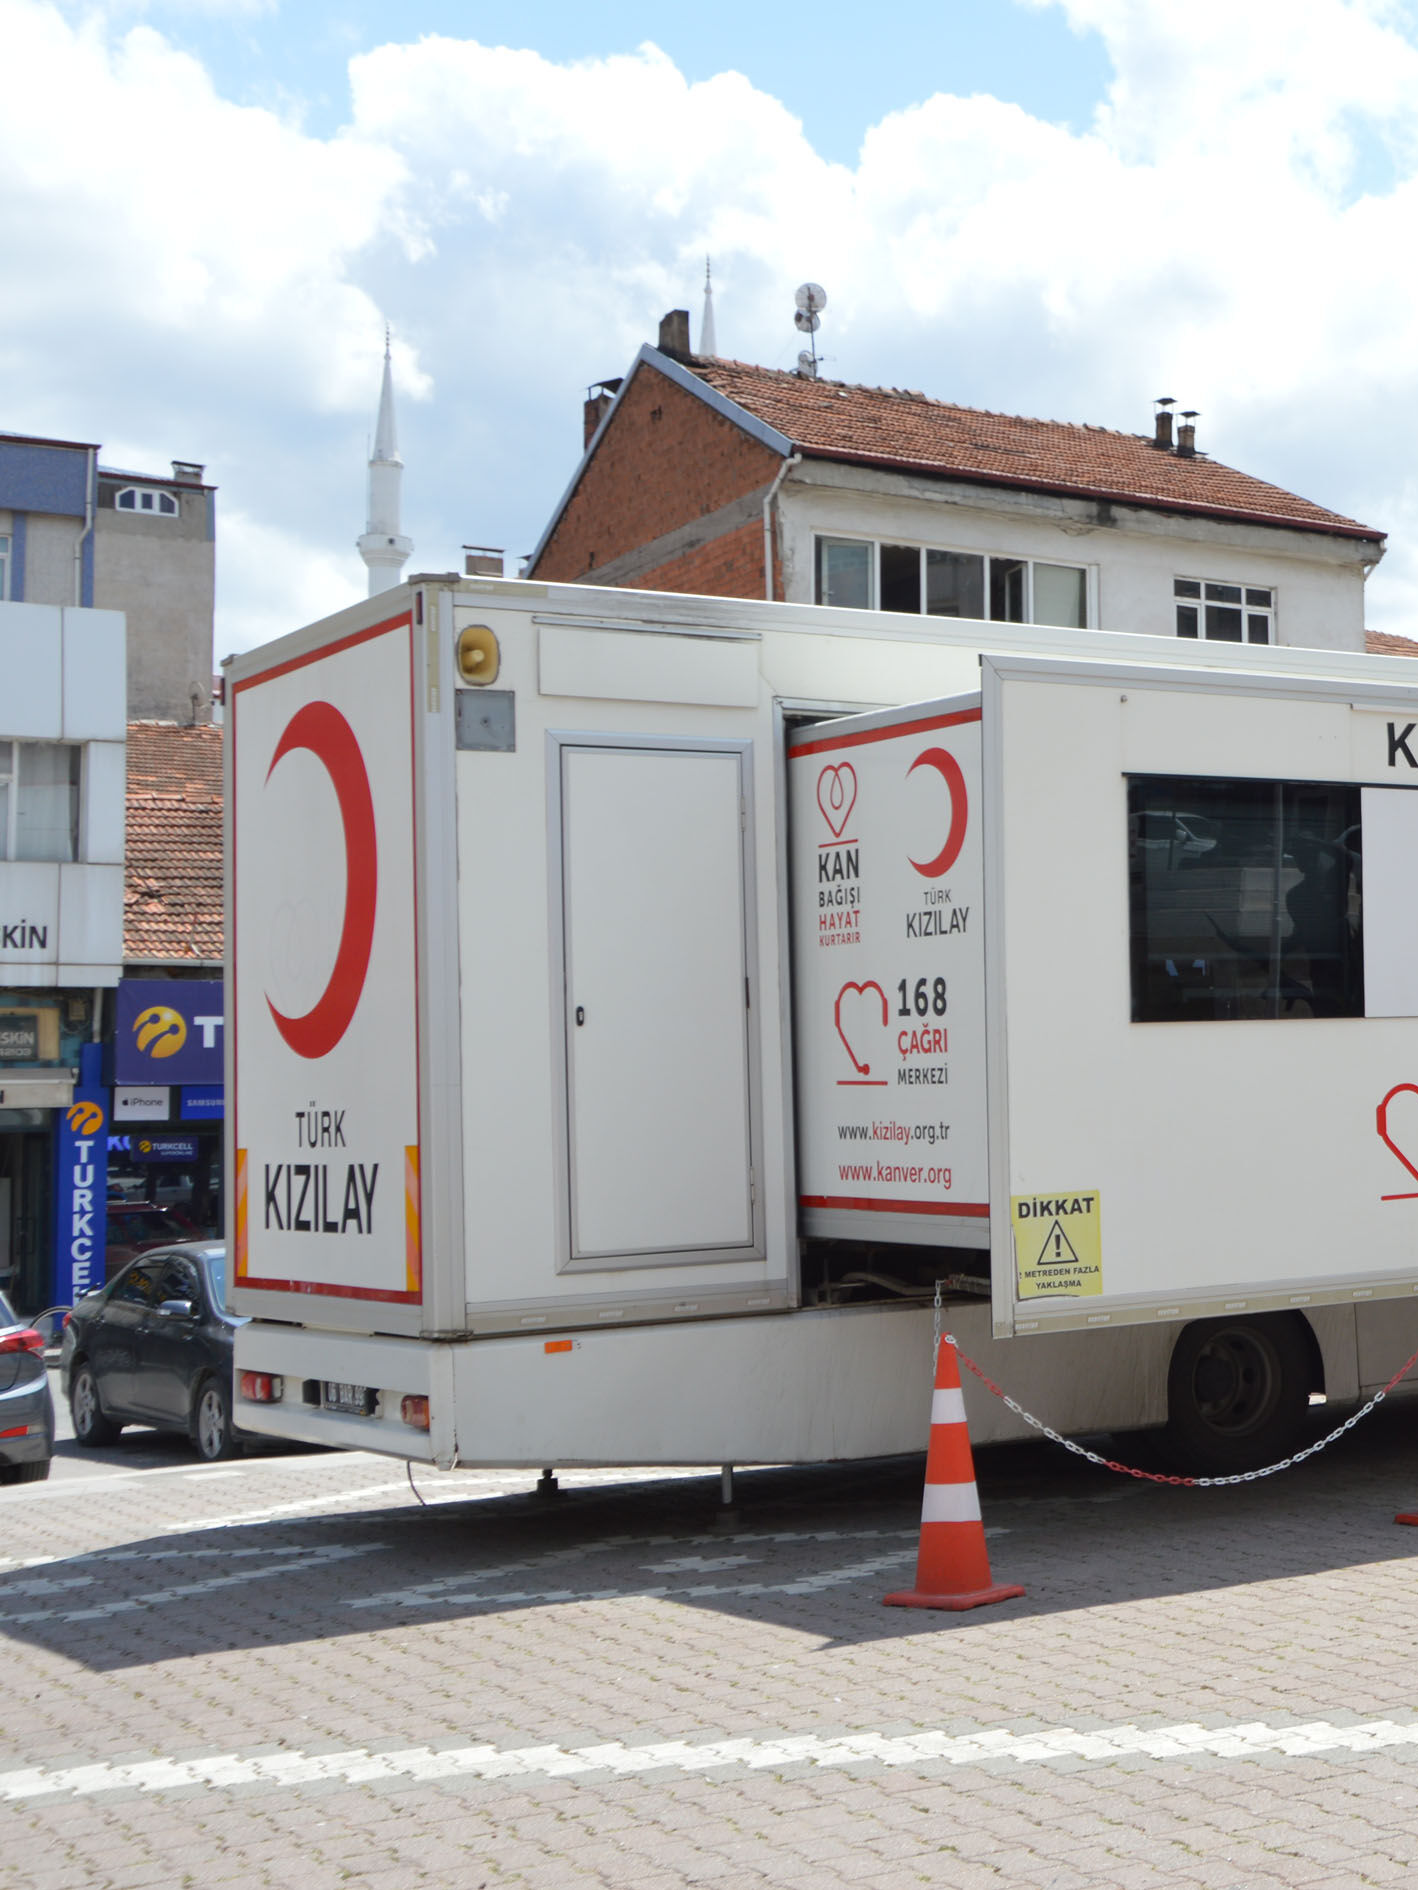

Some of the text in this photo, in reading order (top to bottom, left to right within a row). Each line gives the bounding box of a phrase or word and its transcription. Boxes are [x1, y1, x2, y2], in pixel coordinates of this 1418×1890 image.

[818, 847, 860, 883] KAN
[818, 884, 861, 909] BAĞIŞI
[923, 886, 952, 905] TÜRK
[818, 909, 861, 931] HAYAT
[906, 906, 970, 939] KIZILAY
[818, 931, 861, 947] KURTARIR
[897, 976, 947, 1017] 168
[897, 1023, 948, 1061] ÇAĞRI
[897, 1062, 948, 1086] MERKEZİ
[130, 1097, 163, 1107] iPhone
[295, 1100, 346, 1148] TÜRK
[837, 1120, 950, 1145] www.kizilay.org.tr
[151, 1142, 193, 1151] TURKCELL
[838, 1160, 952, 1190] www.kanver.org
[264, 1163, 379, 1235] KIZILAY
[1018, 1197, 1094, 1219] DİKKAT
[1024, 1268, 1071, 1278] METREDEN
[1073, 1265, 1100, 1275] FAZLA
[1035, 1279, 1082, 1290] YAKLAŞMA
